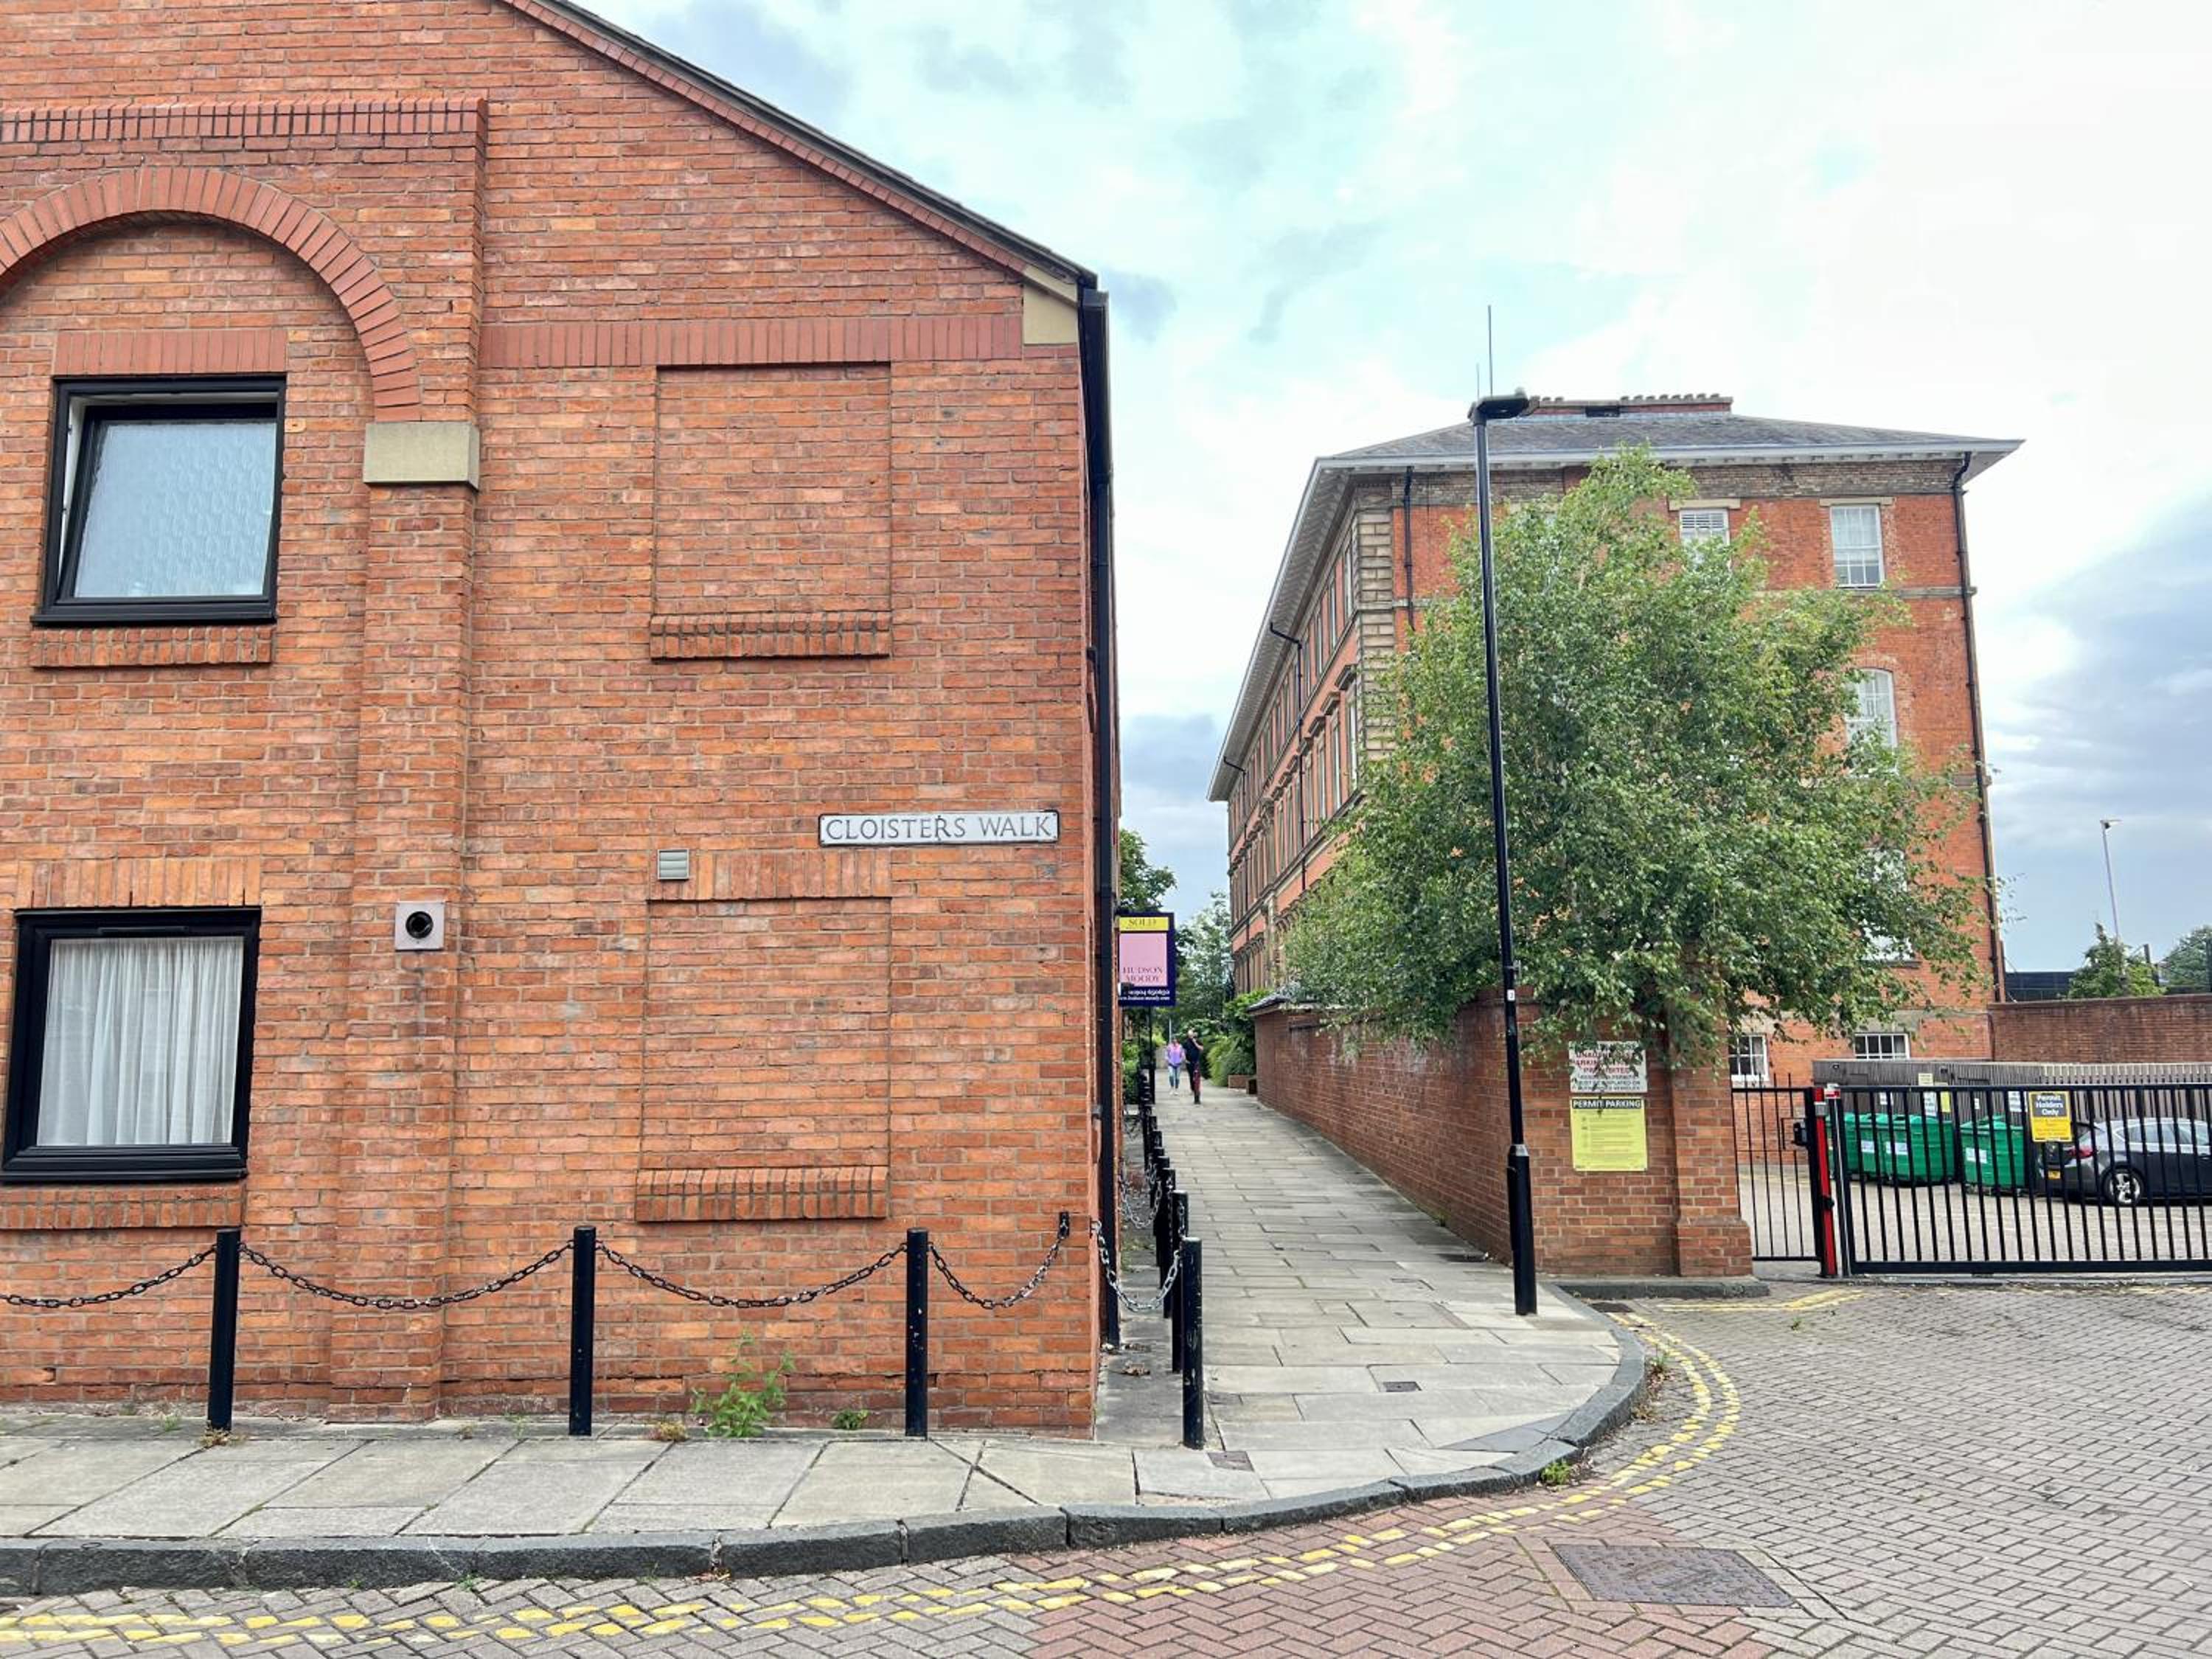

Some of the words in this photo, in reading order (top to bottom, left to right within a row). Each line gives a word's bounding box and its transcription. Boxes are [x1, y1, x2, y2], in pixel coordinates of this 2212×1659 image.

[826, 818, 965, 840] CLOISTERS
[979, 816, 1051, 838] WALK
[1573, 1099, 1603, 1107] PERMIT
[1605, 1099, 1641, 1107] PARKING
[2042, 1108, 2059, 1116] Only
